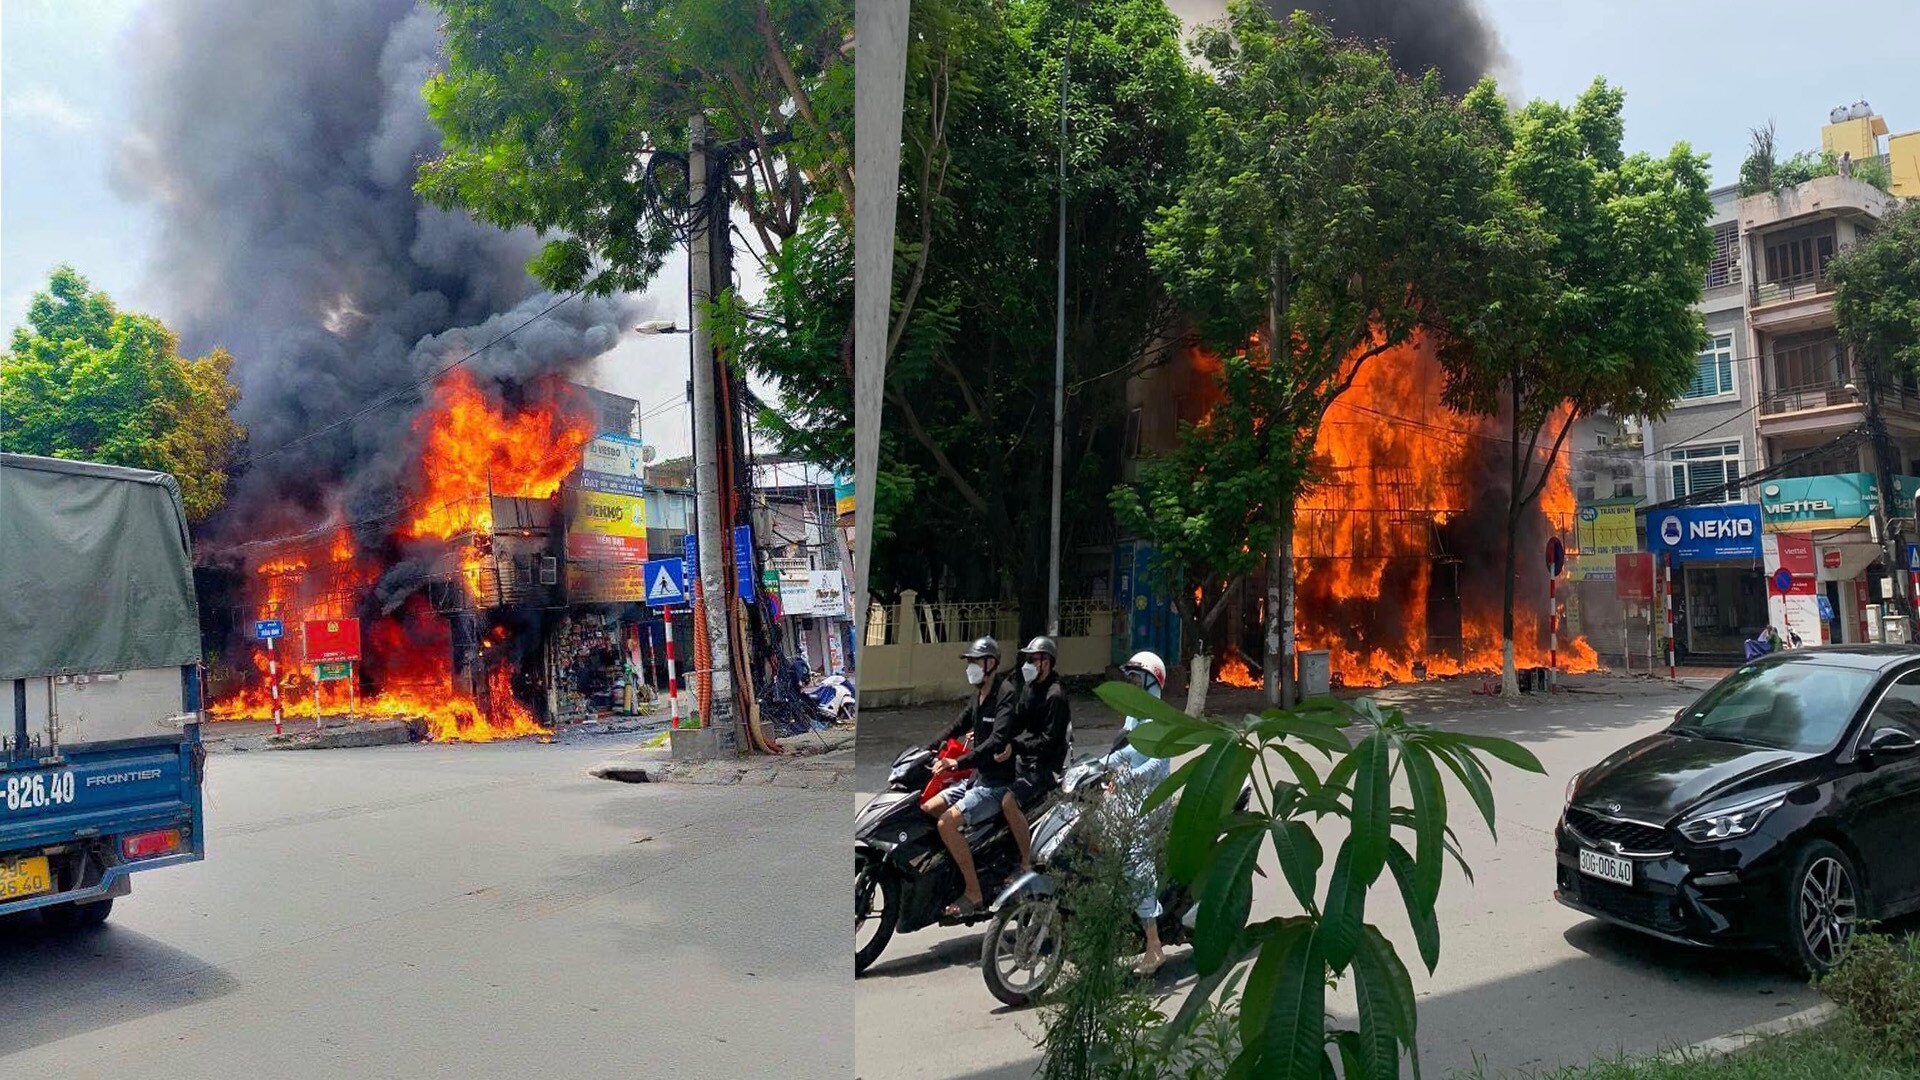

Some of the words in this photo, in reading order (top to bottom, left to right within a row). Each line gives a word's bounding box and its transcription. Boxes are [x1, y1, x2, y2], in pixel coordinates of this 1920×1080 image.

[1765, 500, 1834, 514] VIETTEL
[1689, 518, 1753, 540] NEKIO
[86, 769, 162, 787] FRONTIER
[1581, 852, 1631, 881] 30G-006.40
